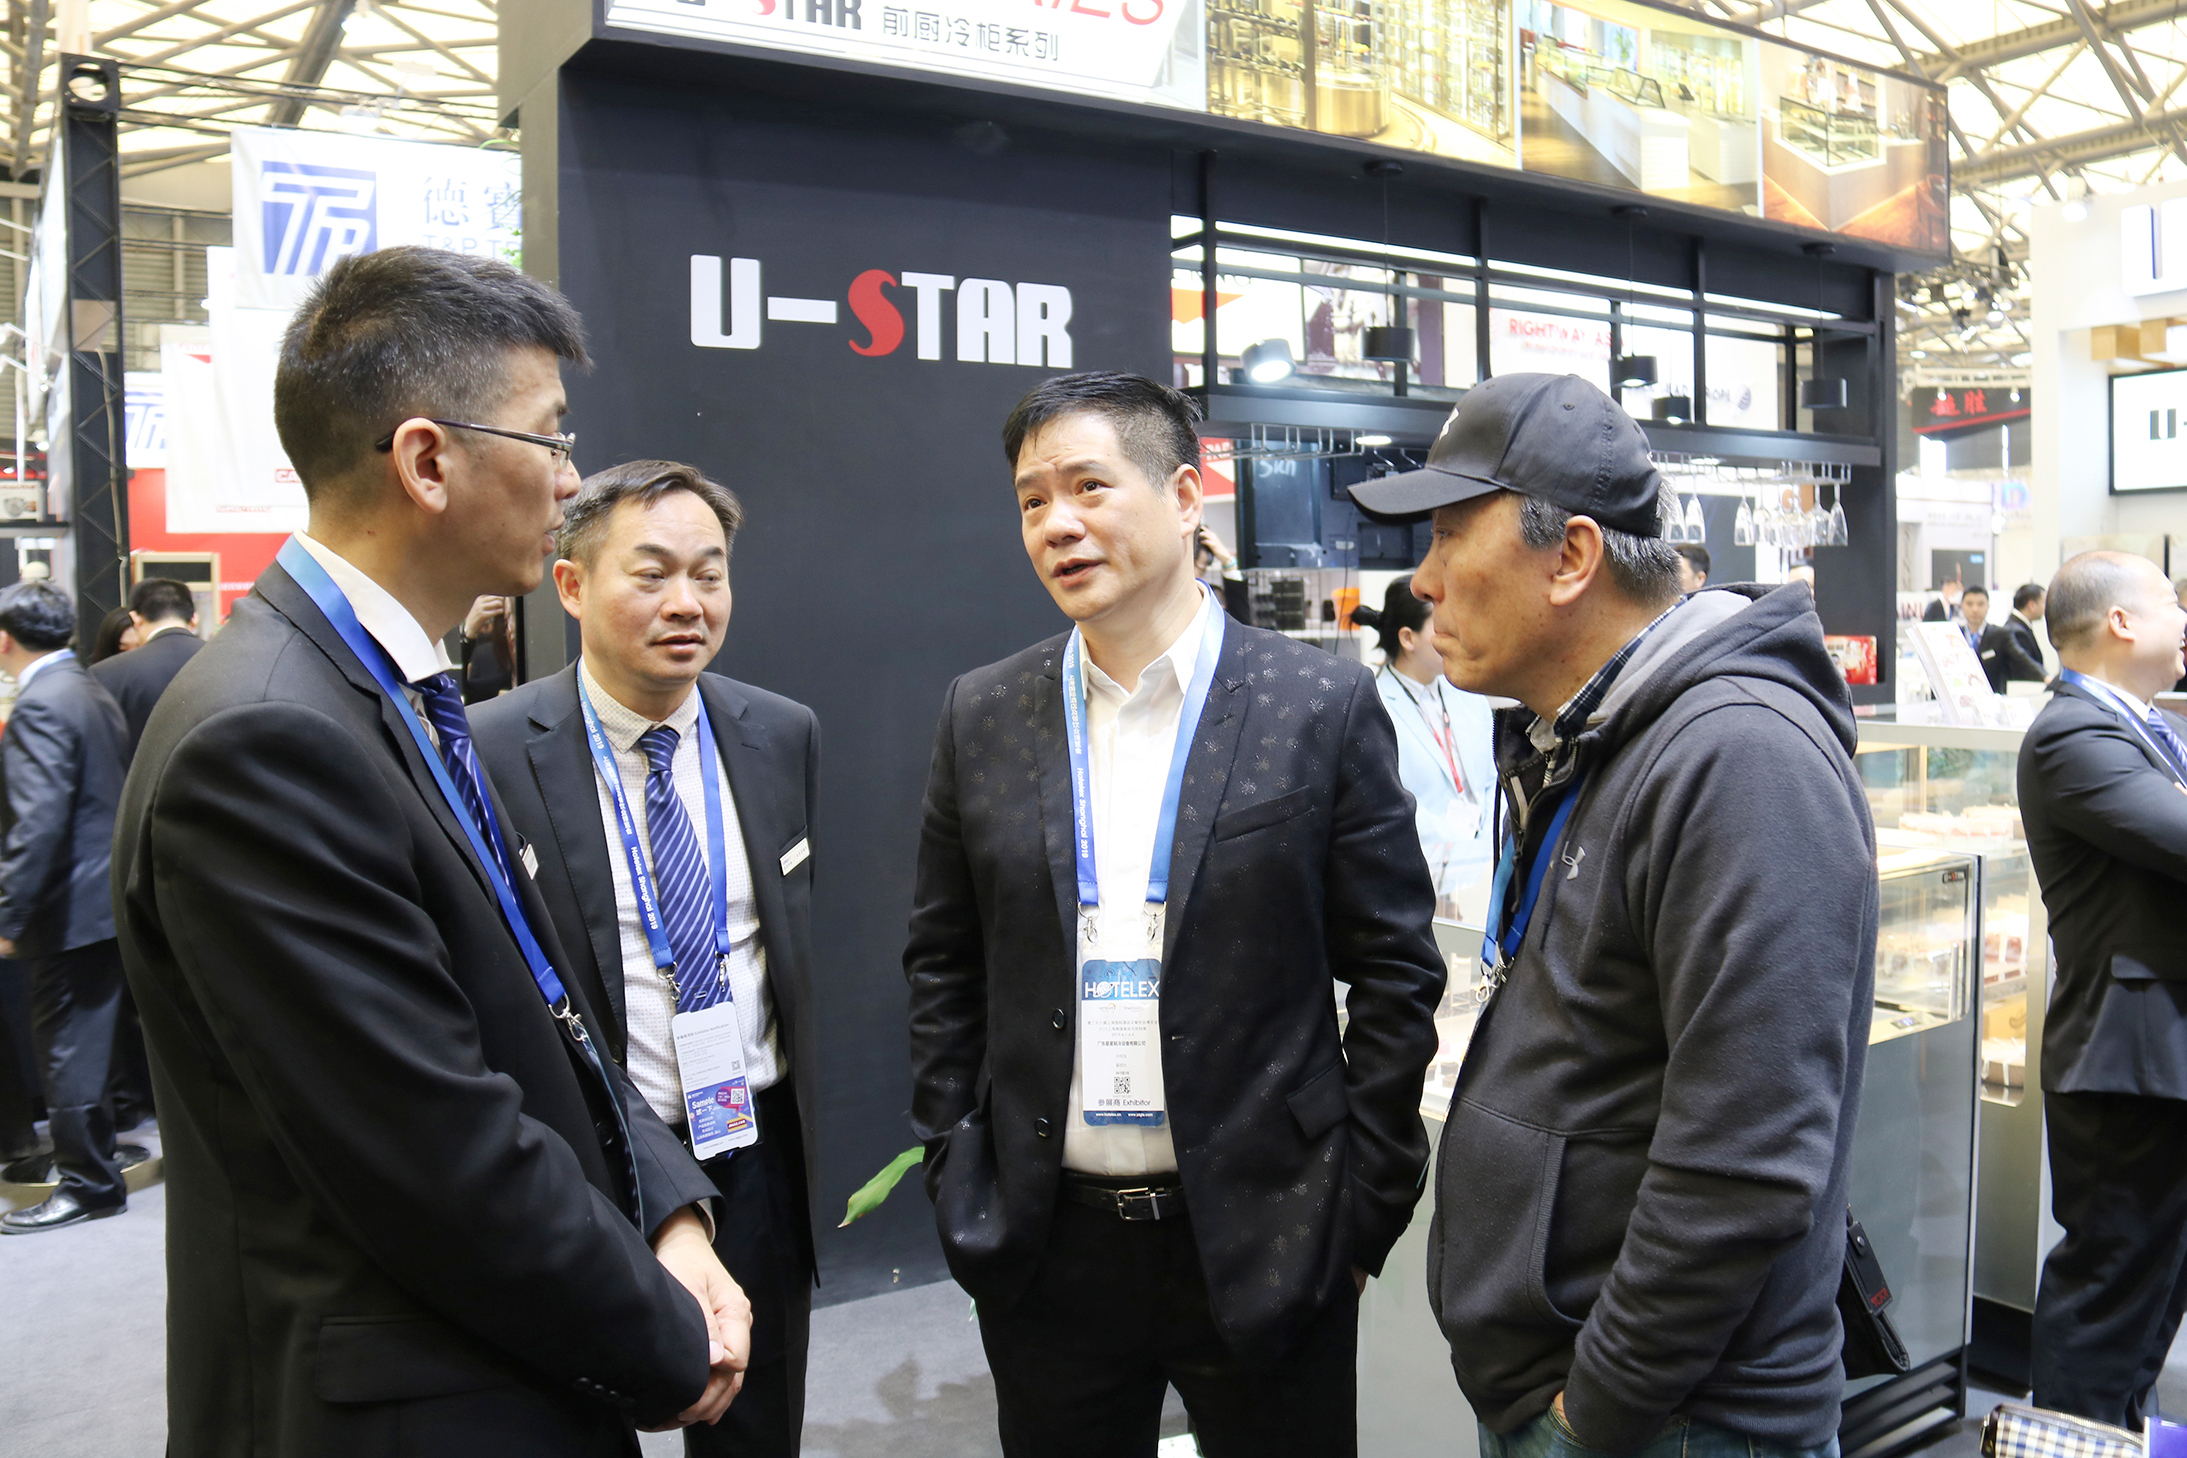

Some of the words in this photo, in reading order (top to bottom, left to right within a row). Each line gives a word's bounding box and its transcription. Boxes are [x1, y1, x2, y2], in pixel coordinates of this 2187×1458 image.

[883, 6, 1058, 61] 前厨冷柜系列
[690, 254, 1072, 369] U-STAR
[592, 733, 605, 750] 2019
[1076, 767, 1085, 798] Hotelex
[1078, 798, 1088, 839] Shanghai
[1081, 839, 1089, 859] 2019
[630, 846, 643, 876] Hotelex
[638, 875, 654, 912] Shanghai
[647, 911, 659, 930] 2019
[1084, 981, 1160, 998] HOTELEX
